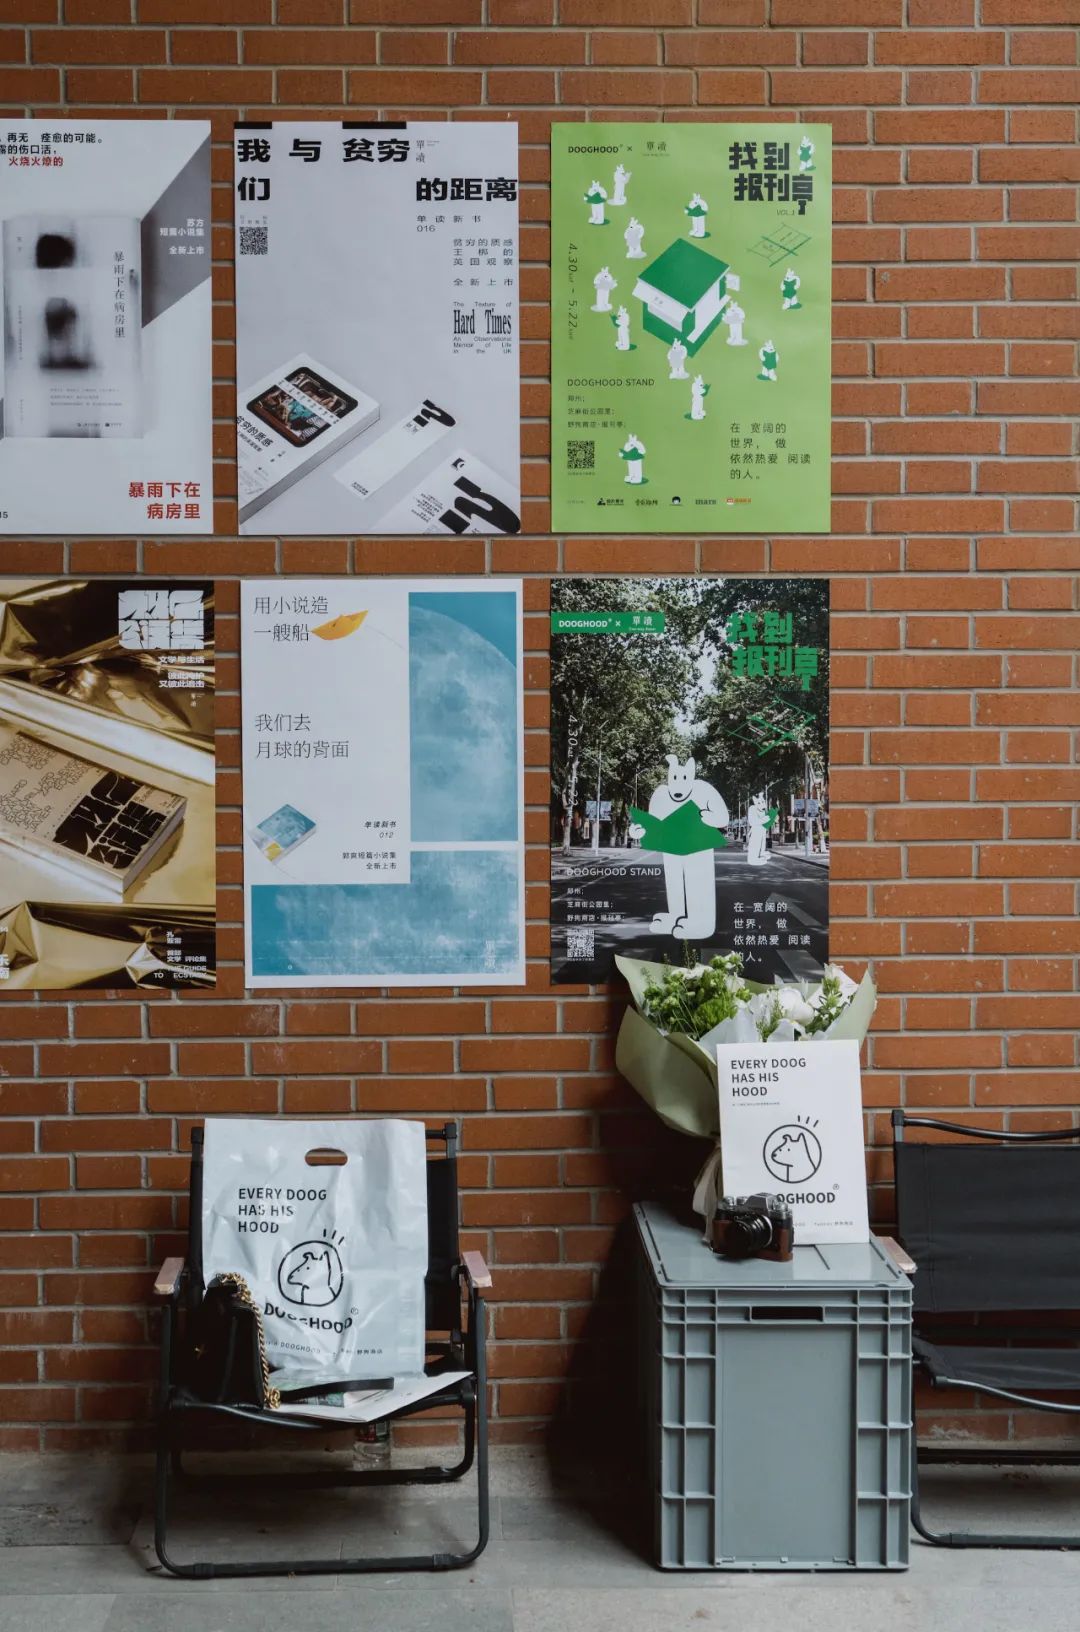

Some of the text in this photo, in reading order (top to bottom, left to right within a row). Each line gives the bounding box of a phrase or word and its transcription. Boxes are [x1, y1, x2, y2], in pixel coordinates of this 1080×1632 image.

[238, 138, 410, 163] 我 与 贫穷
[729, 142, 790, 170] 找到
[416, 177, 517, 202] 的距离
[734, 173, 813, 215] 报刊亭
[453, 307, 512, 334] Hard Times
[567, 379, 623, 387] DOOGHOOD
[730, 422, 786, 433] 在 宽阔的
[730, 453, 811, 464] 依然热爱 阅读
[730, 469, 761, 480] 的人。
[129, 482, 200, 498] 暴雨下在
[147, 503, 200, 519] 病房里
[254, 596, 328, 615] 用小说造
[254, 623, 309, 642] 一艘船
[726, 612, 793, 643] 找到
[732, 646, 818, 692] 报刊亭
[255, 713, 311, 732] 我们去
[256, 740, 350, 759] 月球的背面
[567, 868, 661, 876] DOOGHOOD STAND
[734, 902, 788, 913] 在 宽阔的
[776, 918, 787, 929] 做
[734, 934, 811, 945] 依然热爱 阅读
[731, 1058, 806, 1069] EVERY DOOG
[731, 1072, 779, 1083] HAS HIS
[732, 1087, 768, 1097] HOOD
[238, 1188, 327, 1201] EVERY DOOG
[776, 1192, 836, 1204] OGHOOD
[238, 1205, 294, 1216] HAS HIS
[238, 1221, 279, 1233] HOOD
